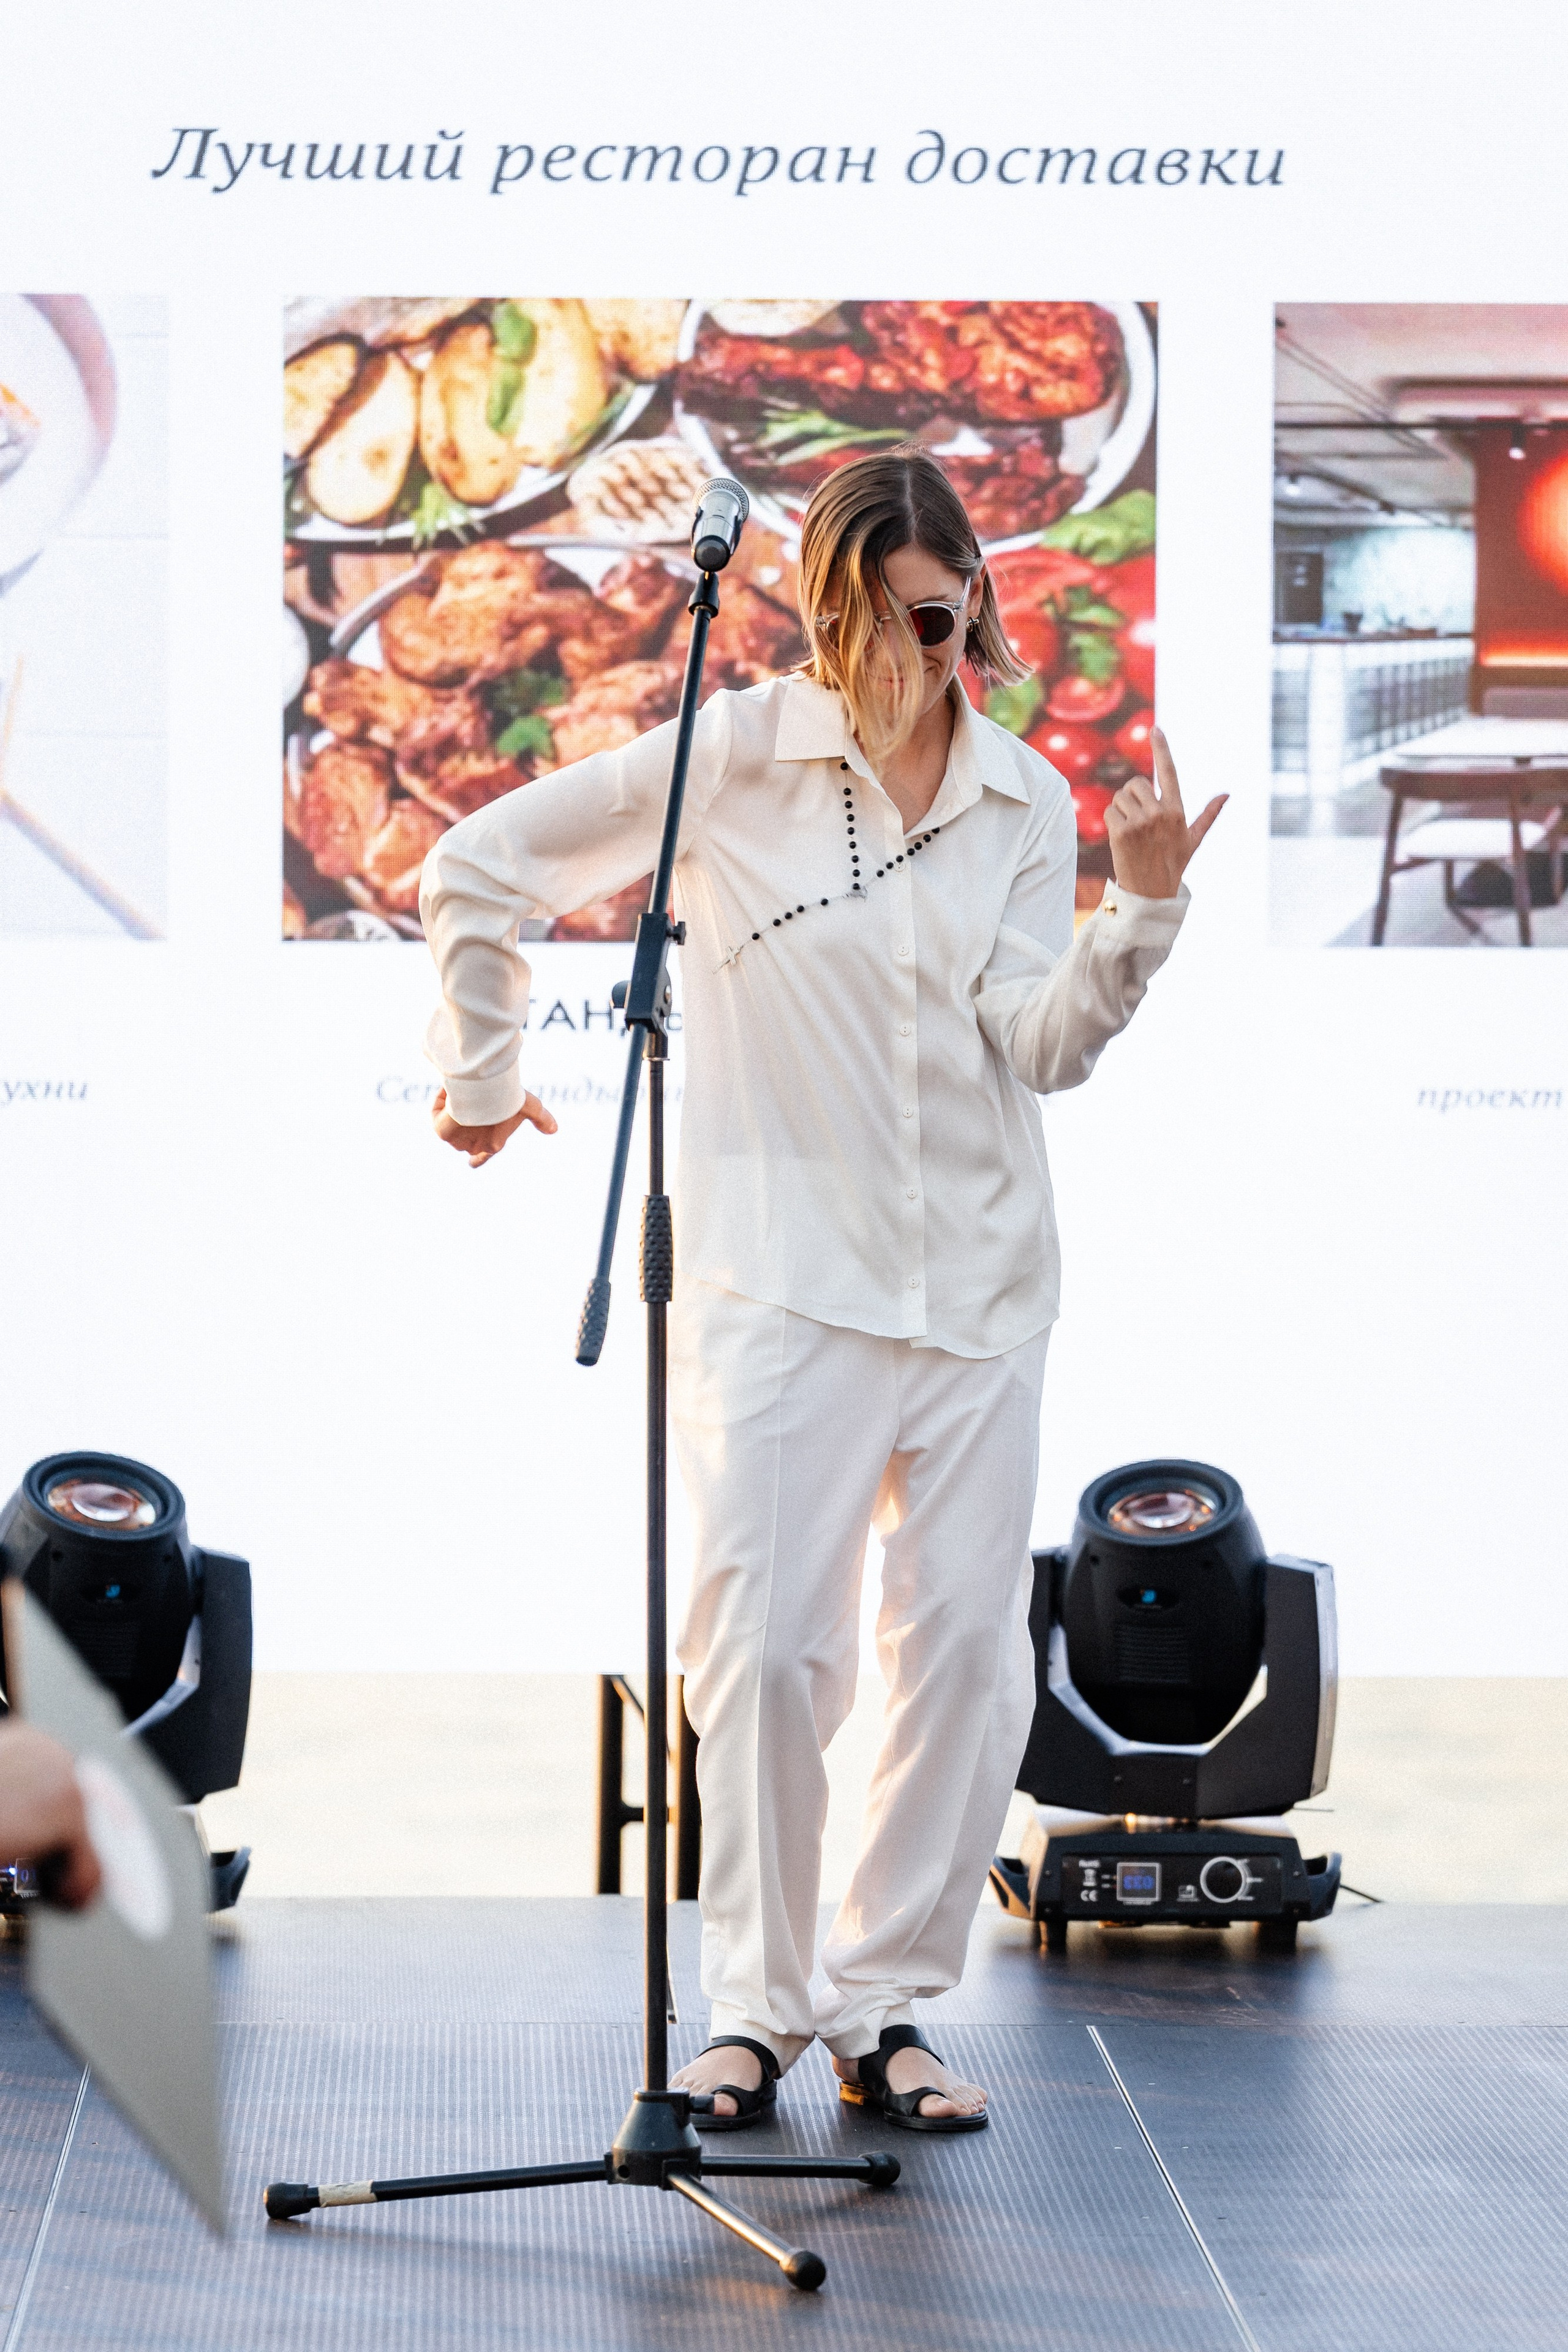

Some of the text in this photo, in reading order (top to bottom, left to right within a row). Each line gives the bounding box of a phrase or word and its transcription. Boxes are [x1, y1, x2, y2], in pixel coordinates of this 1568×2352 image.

[151, 127, 1285, 196] Лучший ресторан доставки
[1417, 1088, 1563, 1114] проект
